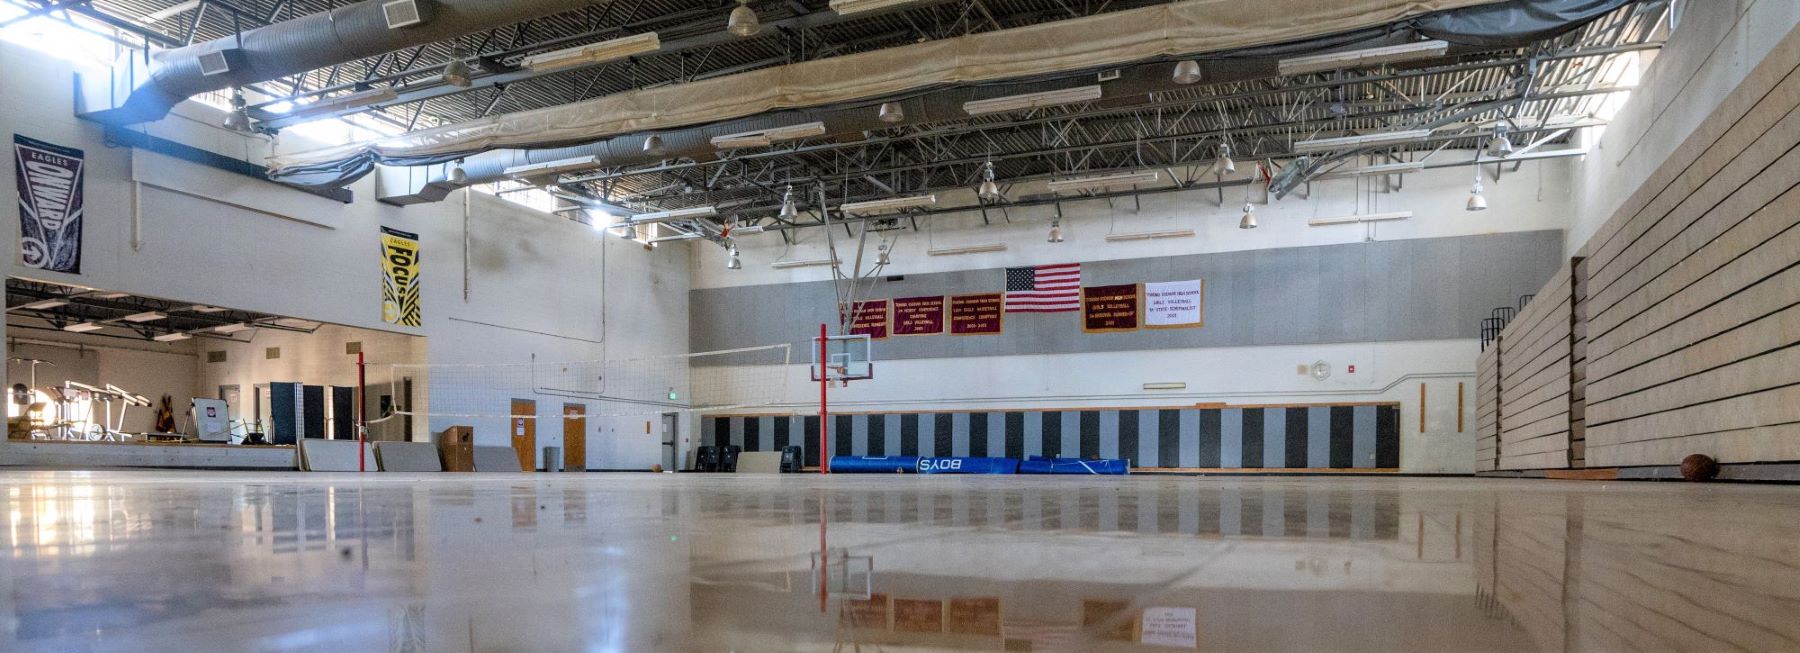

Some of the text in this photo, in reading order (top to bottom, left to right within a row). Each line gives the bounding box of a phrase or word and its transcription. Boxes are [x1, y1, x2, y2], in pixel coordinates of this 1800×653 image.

[31, 152, 69, 167] EAGLES
[25, 160, 74, 231] ONWARD
[387, 245, 413, 295] FOCUS
[919, 459, 962, 471] BOYS
